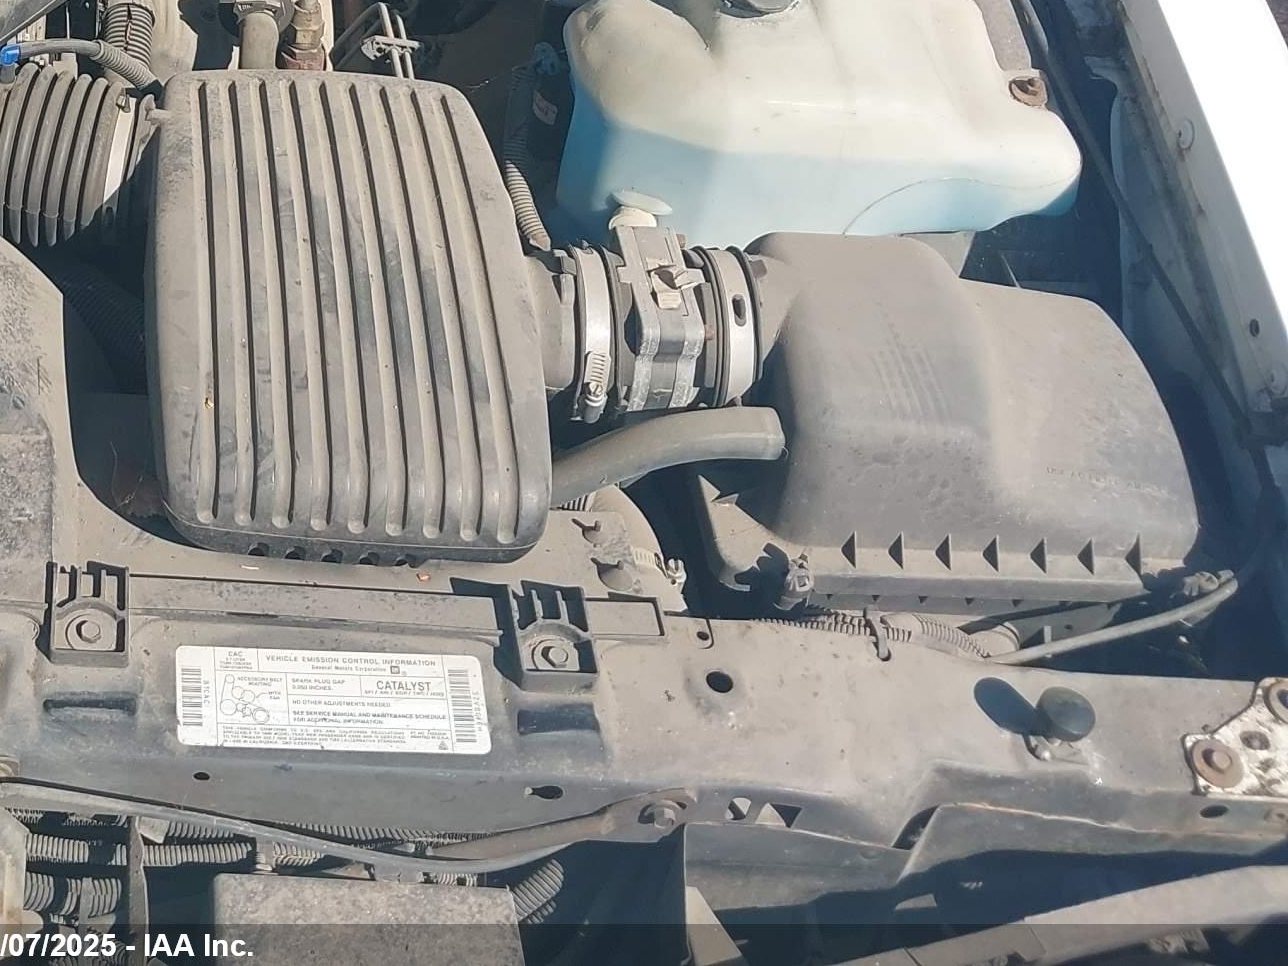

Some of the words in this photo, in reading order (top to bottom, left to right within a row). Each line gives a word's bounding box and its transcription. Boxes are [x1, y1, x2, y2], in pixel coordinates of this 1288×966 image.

[265, 654, 299, 663] VEHICLE
[301, 656, 340, 664] EMISSION
[342, 657, 380, 666] CONTROL
[382, 658, 436, 667] INFORMATION
[376, 680, 432, 691] CATALYST
